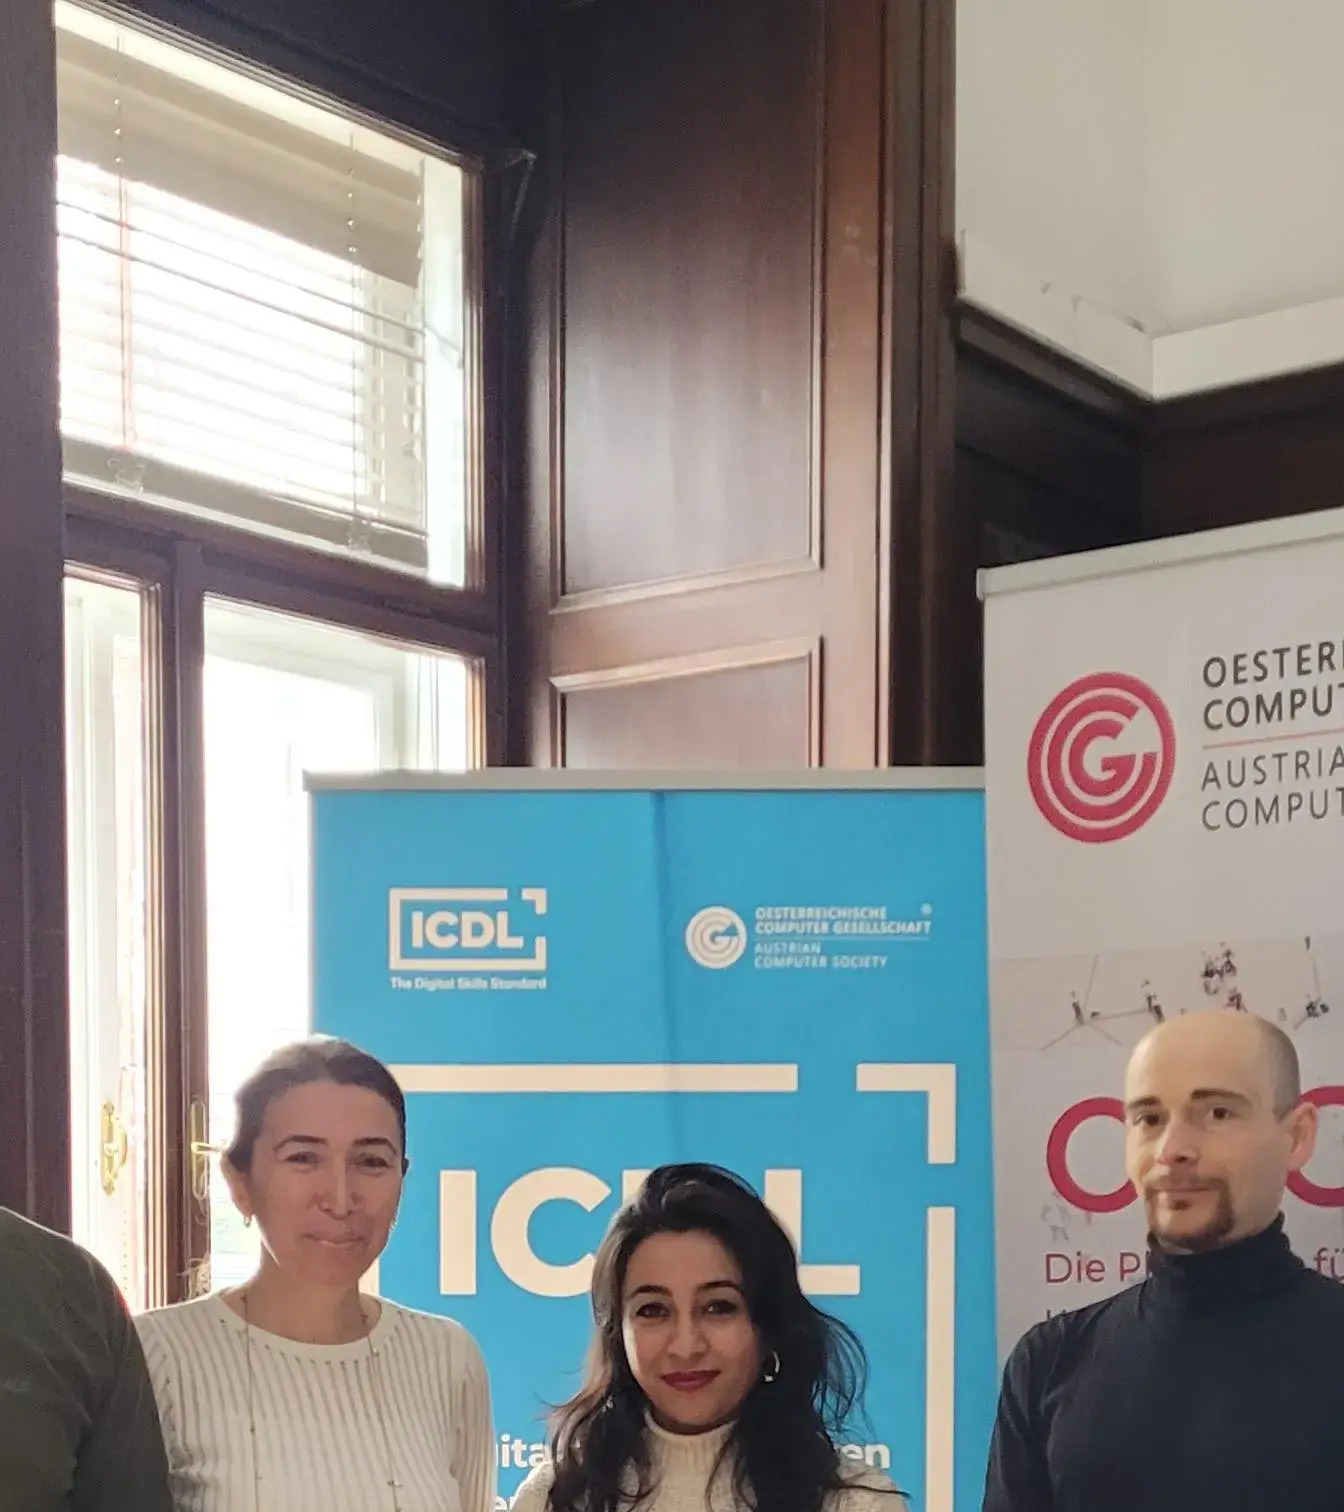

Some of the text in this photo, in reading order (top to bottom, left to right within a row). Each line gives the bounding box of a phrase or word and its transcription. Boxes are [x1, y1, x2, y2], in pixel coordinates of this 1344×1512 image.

[755, 906, 887, 920] OESTERREICHISCHE
[411, 910, 524, 949] ICDL
[755, 920, 931, 934] COMPUTER GESELLSCHAFT
[754, 942, 821, 954] AUSTRIAN
[754, 956, 888, 969] COMPUTER SOCIETY
[390, 976, 546, 991] The Digital Skills Standard
[438, 1166, 861, 1298] ICL
[1045, 1250, 1106, 1284] Die
